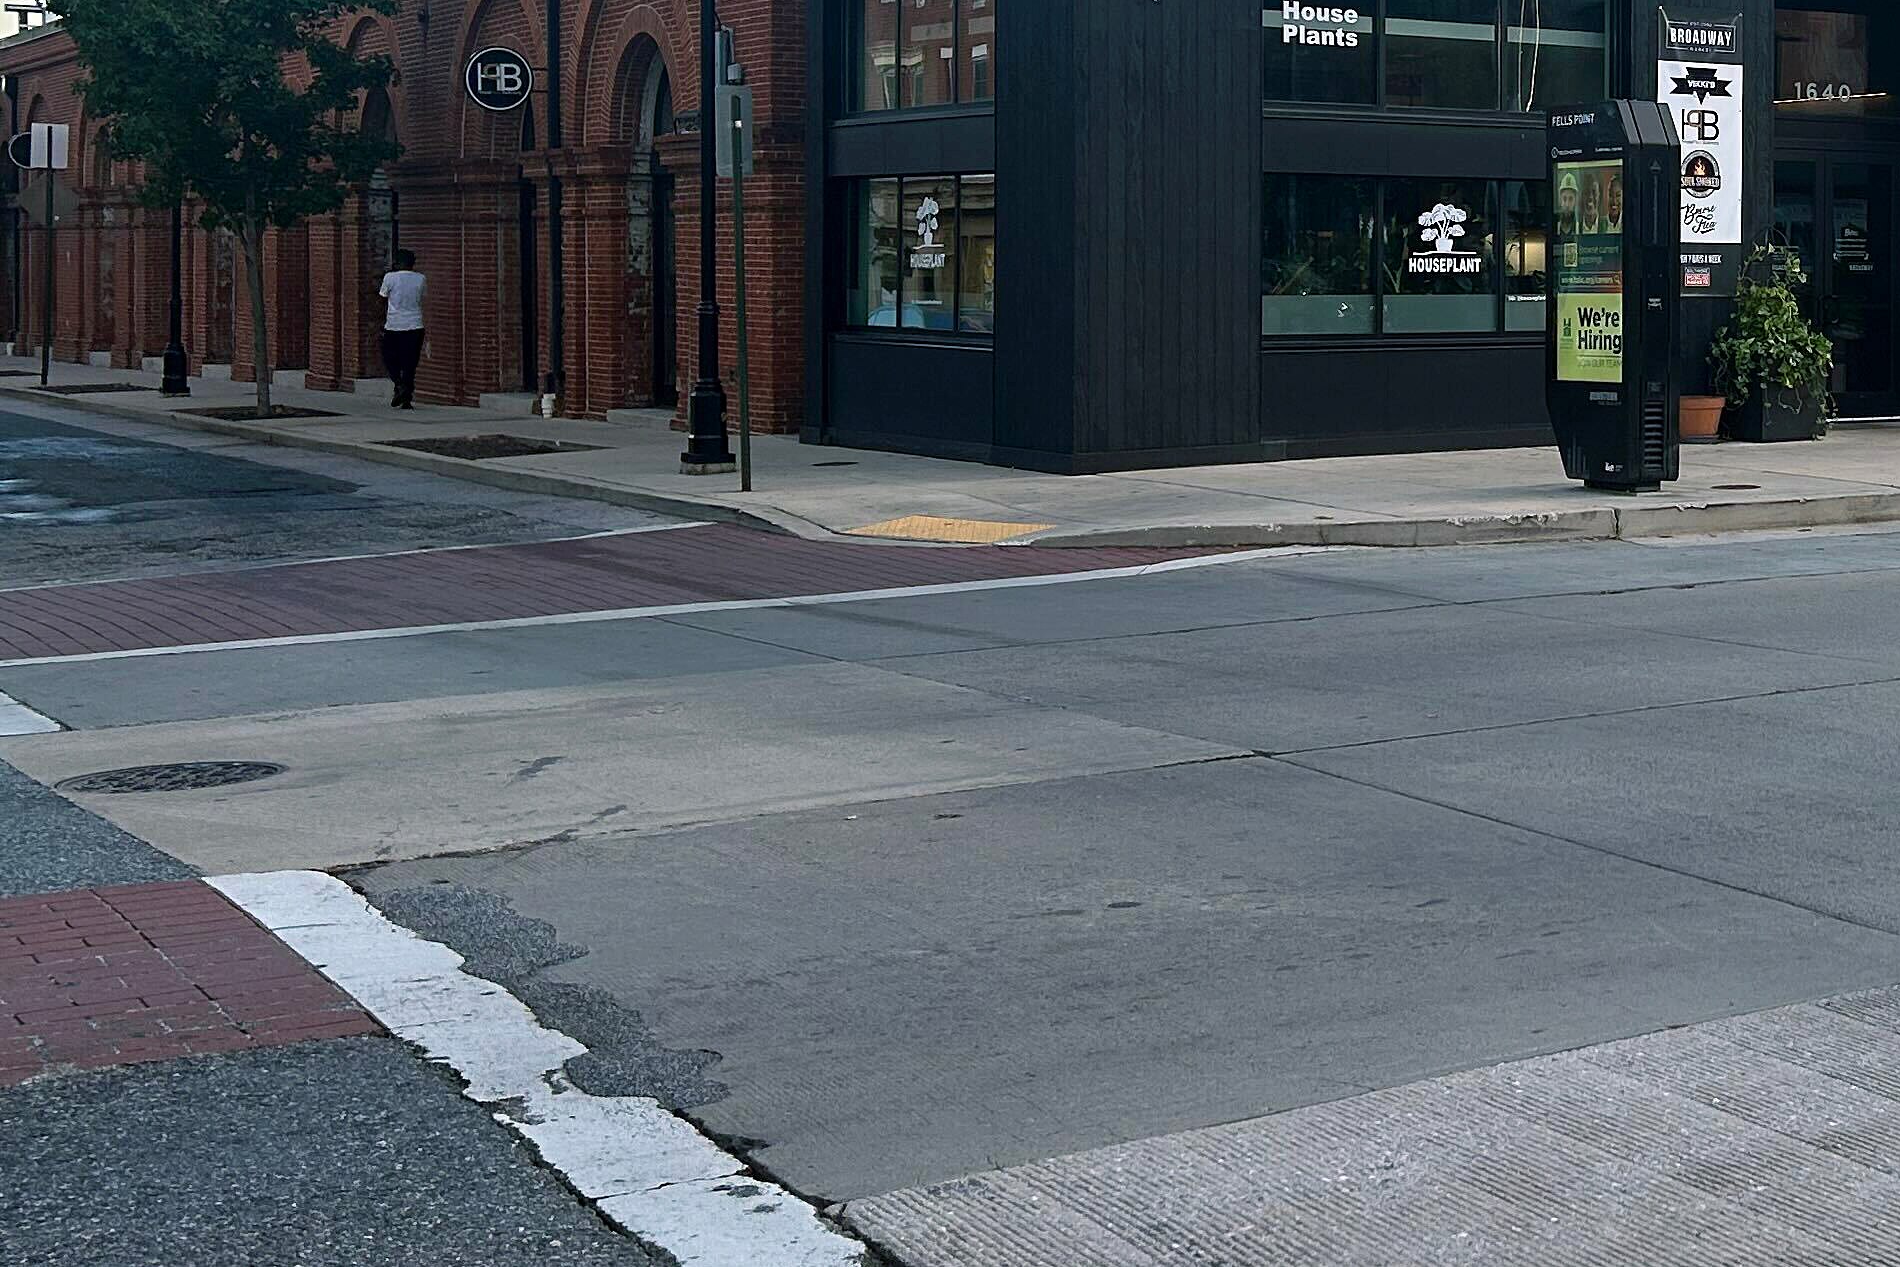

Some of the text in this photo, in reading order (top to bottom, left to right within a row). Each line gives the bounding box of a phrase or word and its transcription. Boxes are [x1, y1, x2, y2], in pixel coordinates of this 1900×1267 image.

[1283, 0, 1359, 24] House
[1283, 24, 1358, 47] Plants
[1669, 27, 1732, 46] BROADWAY
[1794, 81, 1852, 103] 1640
[1552, 112, 1595, 127] FELLS POINT
[1408, 257, 1482, 273] HOUSEPLANT
[1577, 307, 1620, 328] We're
[1577, 329, 1622, 354] Hiring
